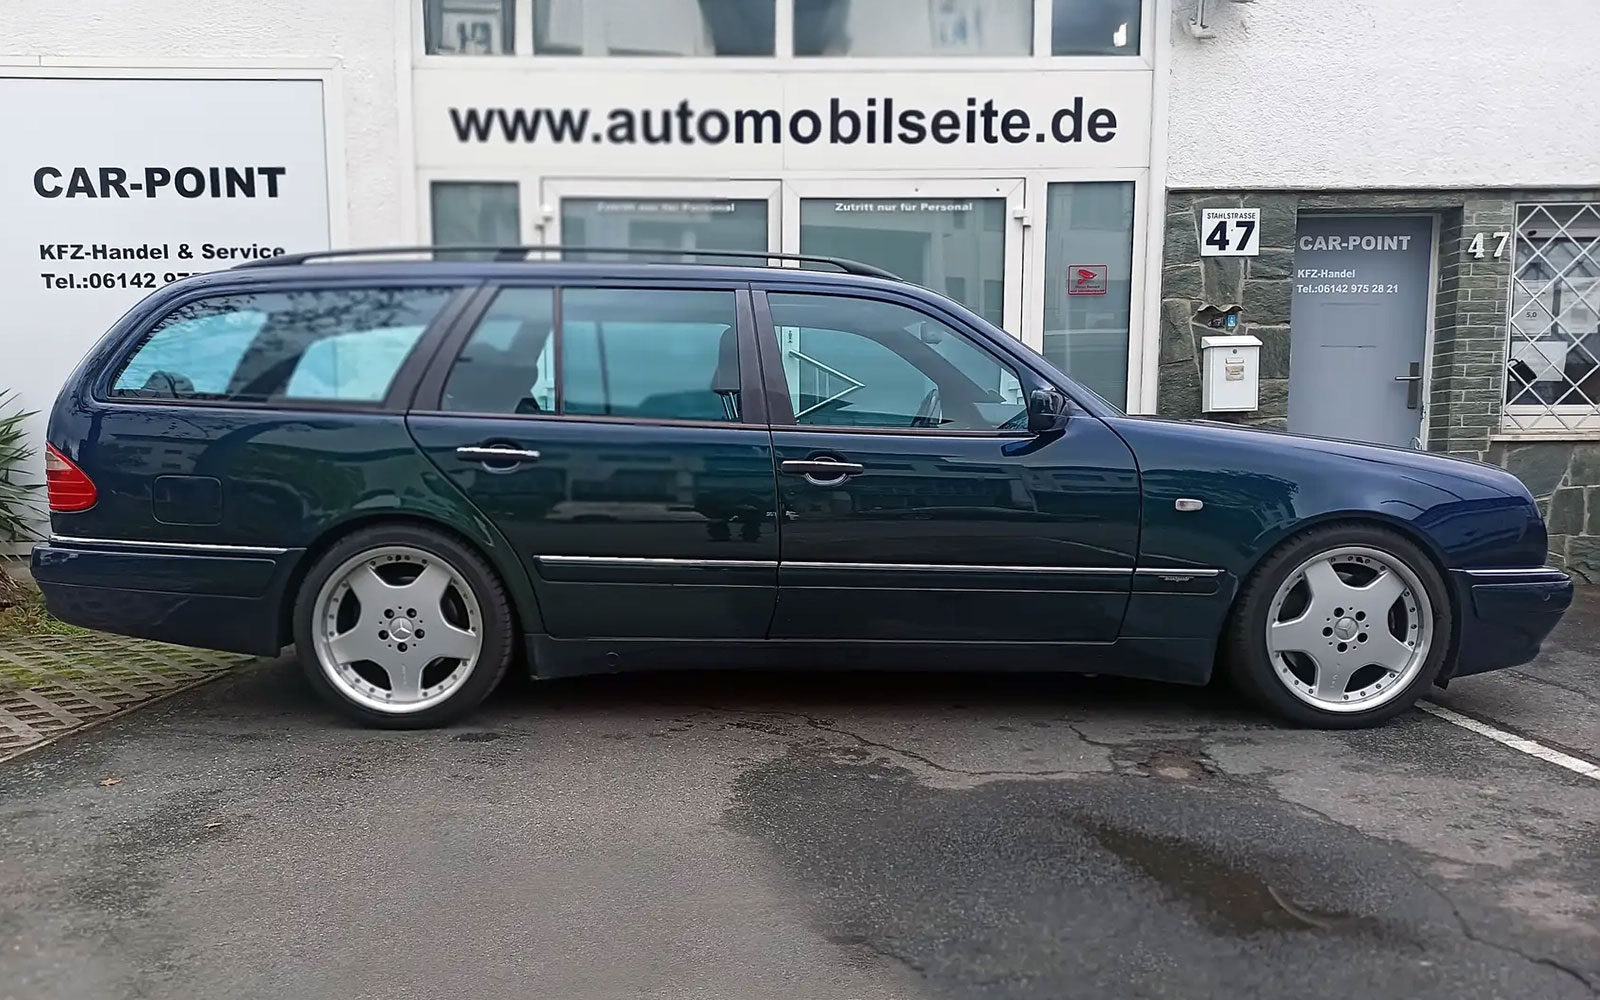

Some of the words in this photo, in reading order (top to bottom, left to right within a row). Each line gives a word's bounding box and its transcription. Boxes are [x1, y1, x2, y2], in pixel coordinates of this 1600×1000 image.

[448, 97, 1117, 144] www.automobilseite.de
[33, 166, 286, 199] CAR-POINT
[835, 203, 873, 211] Zutritt
[900, 203, 917, 211] für
[920, 202, 973, 211] Personal
[1206, 221, 1255, 251] 47
[1299, 235, 1411, 251] CAR-POINT
[40, 244, 169, 260] KFZ-Handel
[177, 244, 194, 260] &
[202, 244, 286, 259] Service
[41, 273, 157, 290] Tel.:06142
[1297, 269, 1356, 278] KFZ-Handel
[1296, 284, 1349, 293] Tel.:06142
[1351, 284, 1369, 293] 975
[1371, 284, 1384, 293] 28
[1386, 284, 1399, 293] 21
